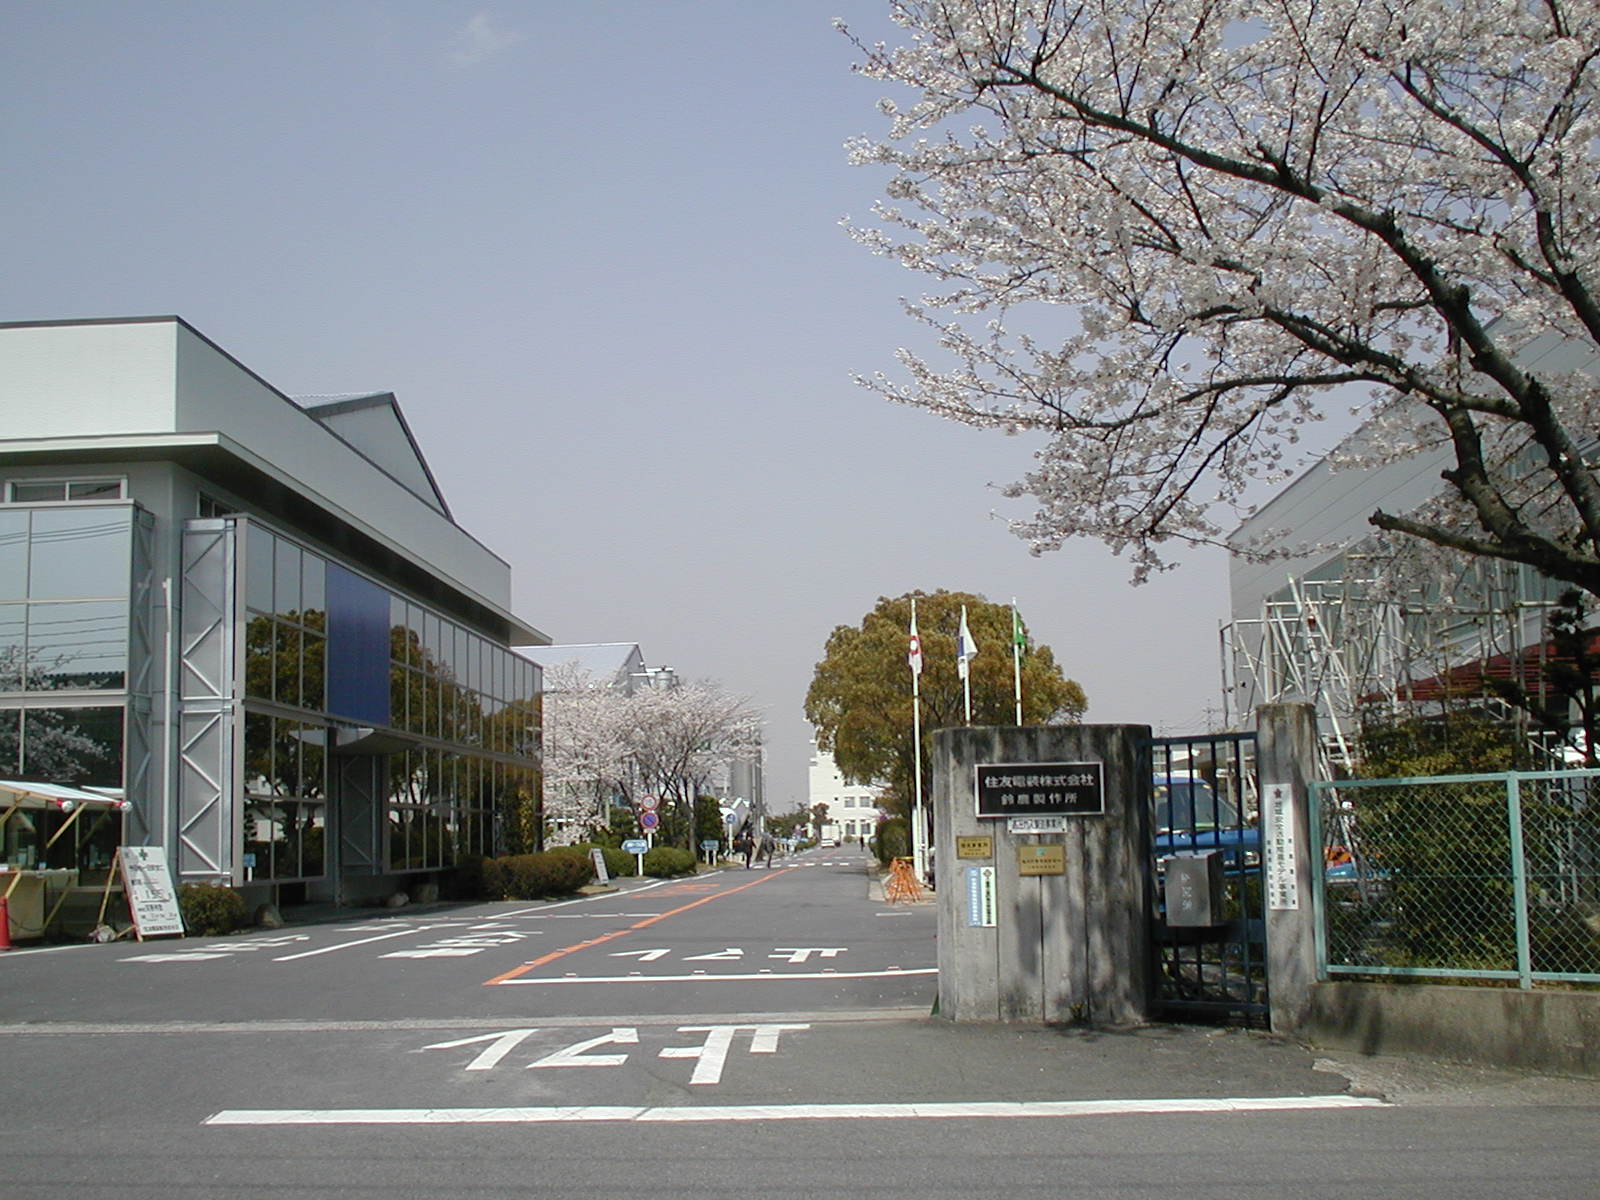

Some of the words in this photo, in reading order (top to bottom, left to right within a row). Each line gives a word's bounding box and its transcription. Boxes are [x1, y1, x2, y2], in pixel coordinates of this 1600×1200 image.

[985, 774, 1094, 788] 住友電装株式会社
[1001, 792, 1077, 805] 鈴鹿製作所
[422, 1024, 811, 1085] 止マレ
